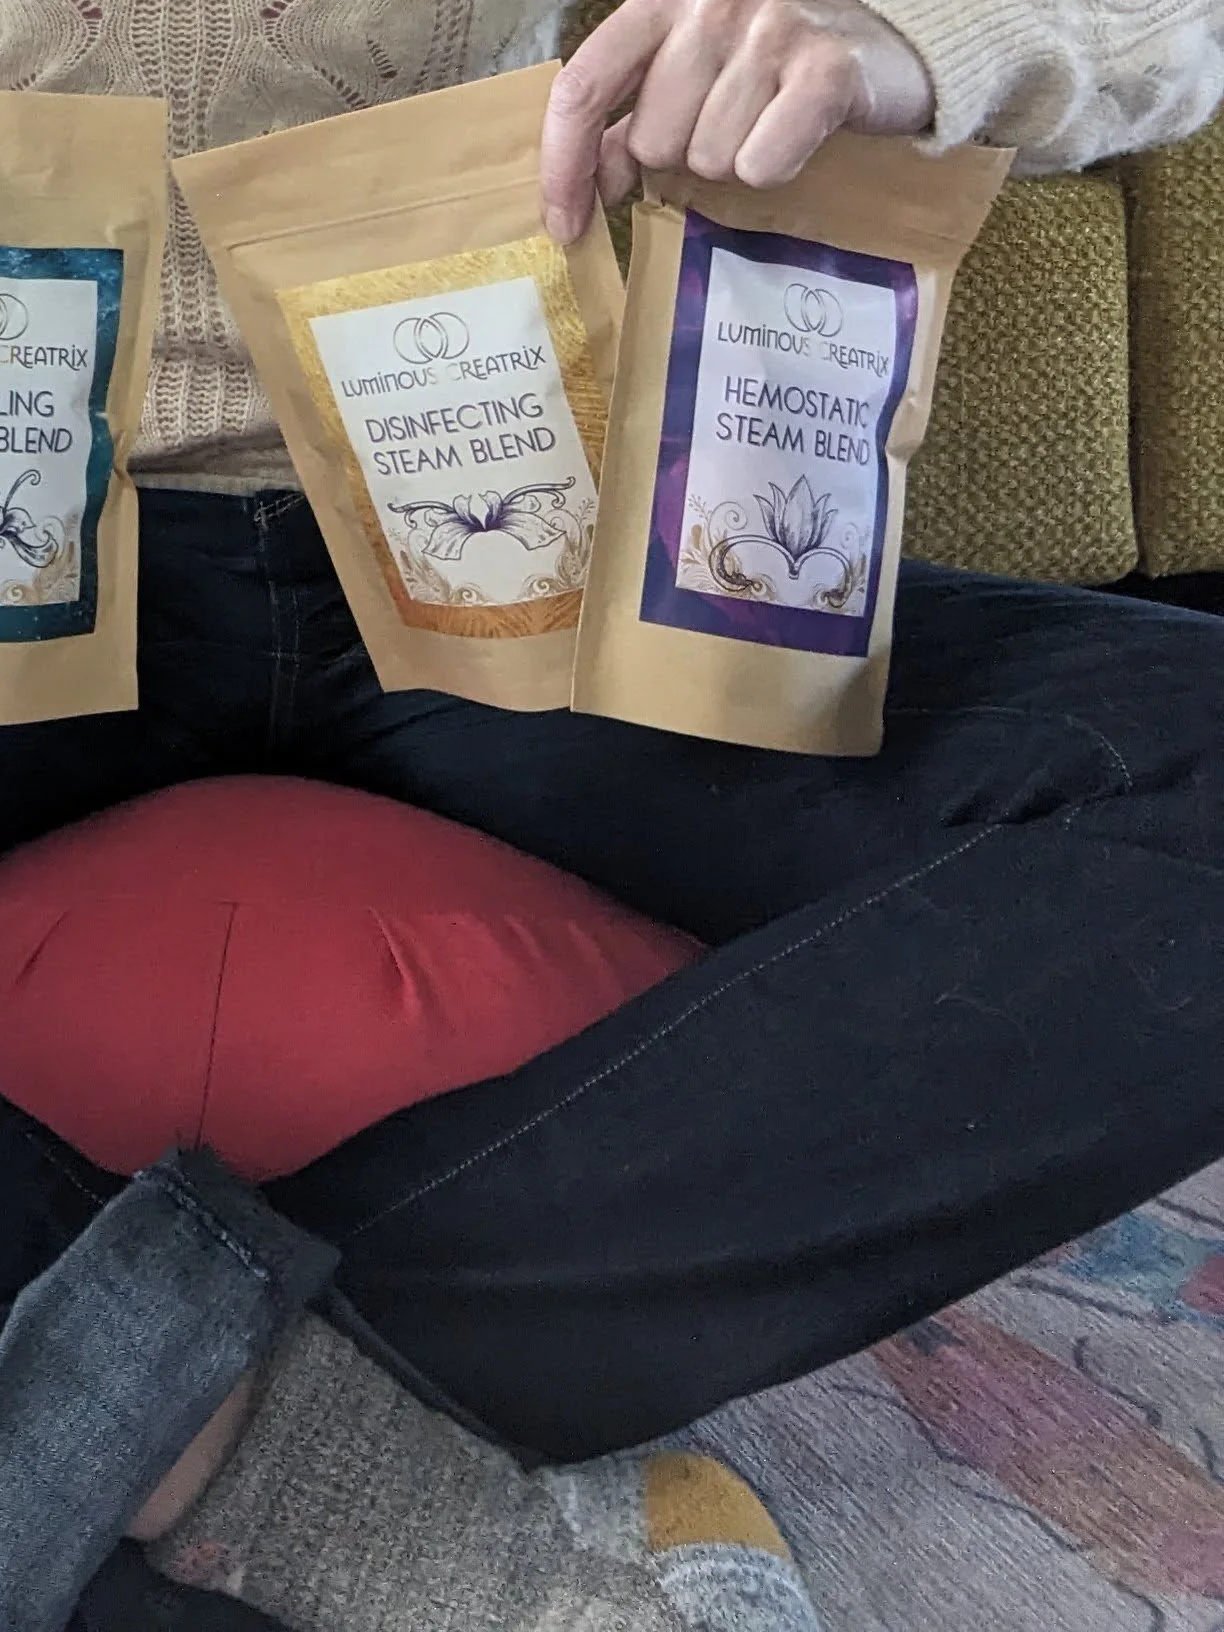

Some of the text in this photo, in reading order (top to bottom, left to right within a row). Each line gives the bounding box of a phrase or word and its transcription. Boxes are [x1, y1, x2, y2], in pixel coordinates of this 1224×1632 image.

[365, 393, 544, 443] DISINFECTING
[725, 375, 871, 429] HEMOSTATIC
[373, 427, 556, 476] STEAM BLEND
[716, 413, 870, 466] STEAM BLEND
